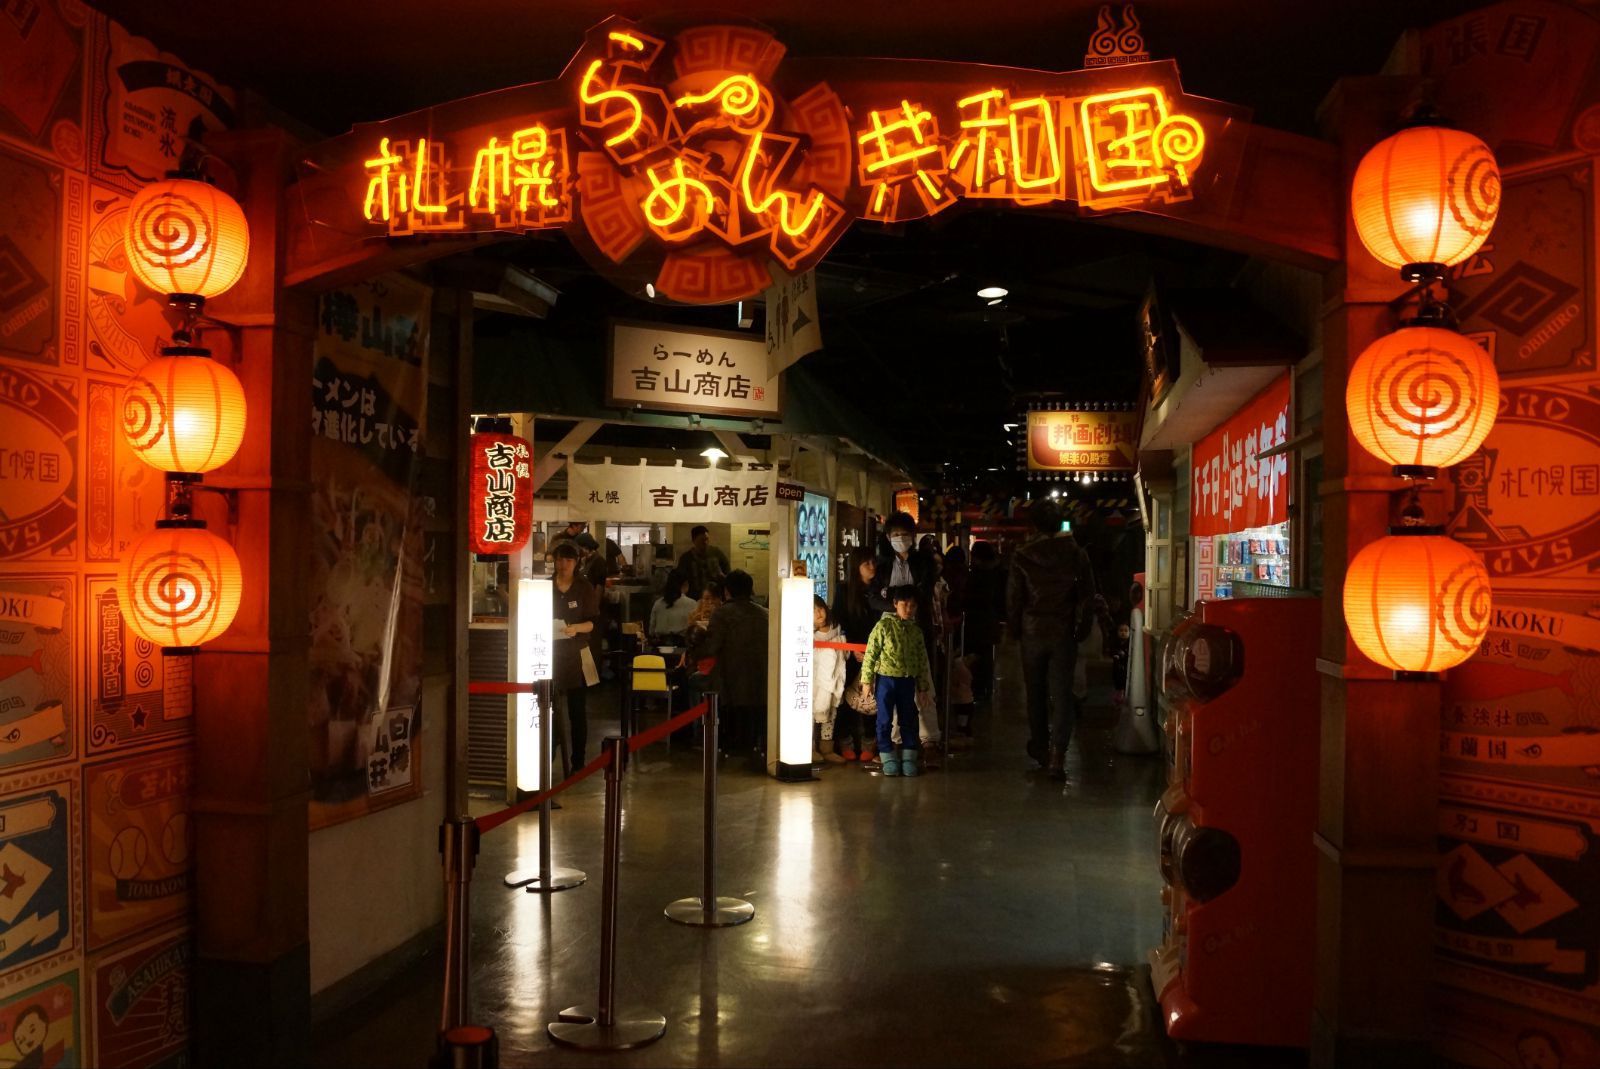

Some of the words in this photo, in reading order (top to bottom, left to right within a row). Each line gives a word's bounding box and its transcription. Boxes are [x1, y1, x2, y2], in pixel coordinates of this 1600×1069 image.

[362, 125, 559, 222] 札幌
[858, 85, 1205, 214] 共和国
[1518, 303, 1580, 359] OBIHIRO
[653, 343, 736, 368] らーめん
[631, 366, 751, 399] 吉山商店
[516, 443, 530, 478] 札幌
[484, 442, 516, 542] 吉山商店
[588, 490, 620, 504] 札幌
[649, 485, 769, 508] 吉山商店
[778, 484, 802, 499] open
[1500, 464, 1600, 498] 札幌国
[1490, 609, 1565, 637] KOKU
[102, 603, 122, 699] 富良野国
[794, 650, 810, 710] 吉山商店
